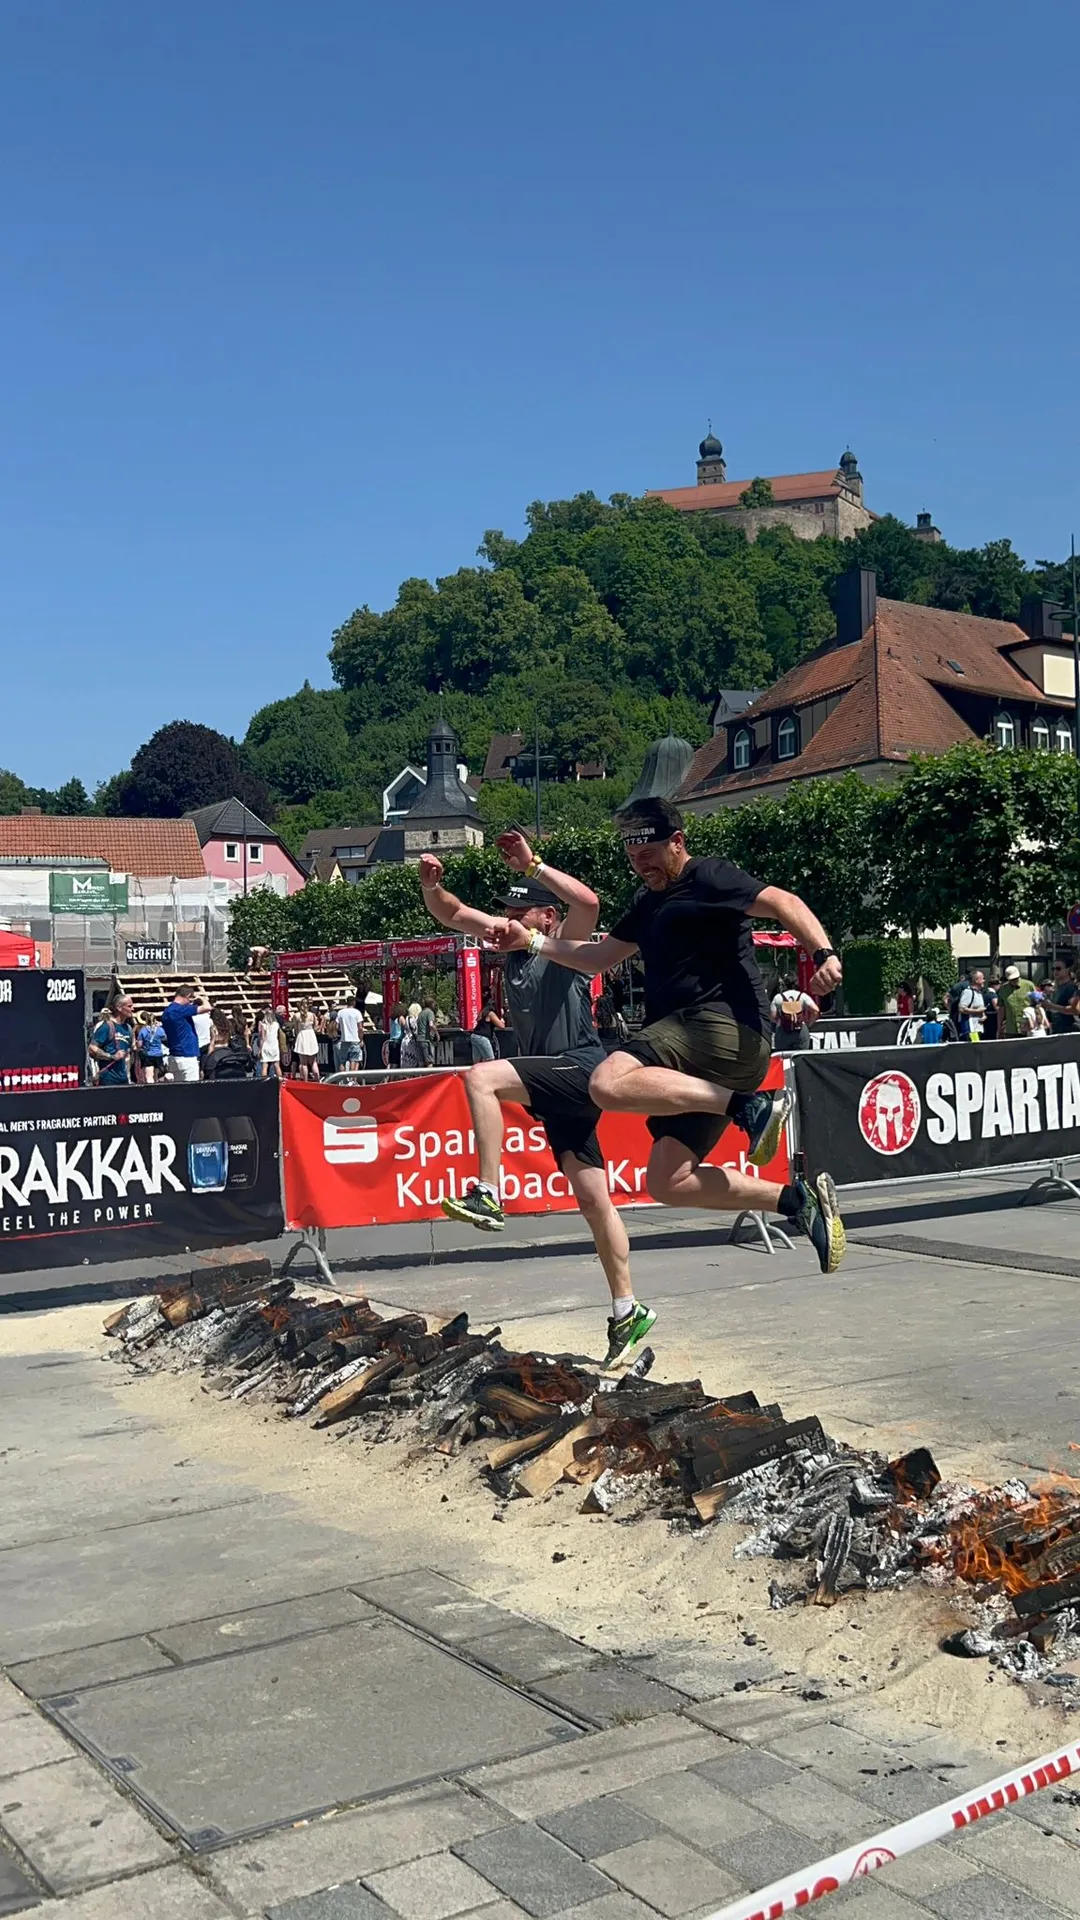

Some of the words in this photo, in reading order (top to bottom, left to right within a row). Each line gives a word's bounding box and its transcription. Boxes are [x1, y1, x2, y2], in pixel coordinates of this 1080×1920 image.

[126, 946, 172, 960] GEÖFFNET
[47, 978, 76, 1002] 2025
[10, 1120, 35, 1132] MEN'S
[37, 1117, 81, 1130] FRAGRANCE
[83, 1114, 117, 1127] PARTNER
[129, 1112, 163, 1124] SPARTAN
[48, 1210, 80, 1227] THE
[94, 1203, 153, 1222] POWER
